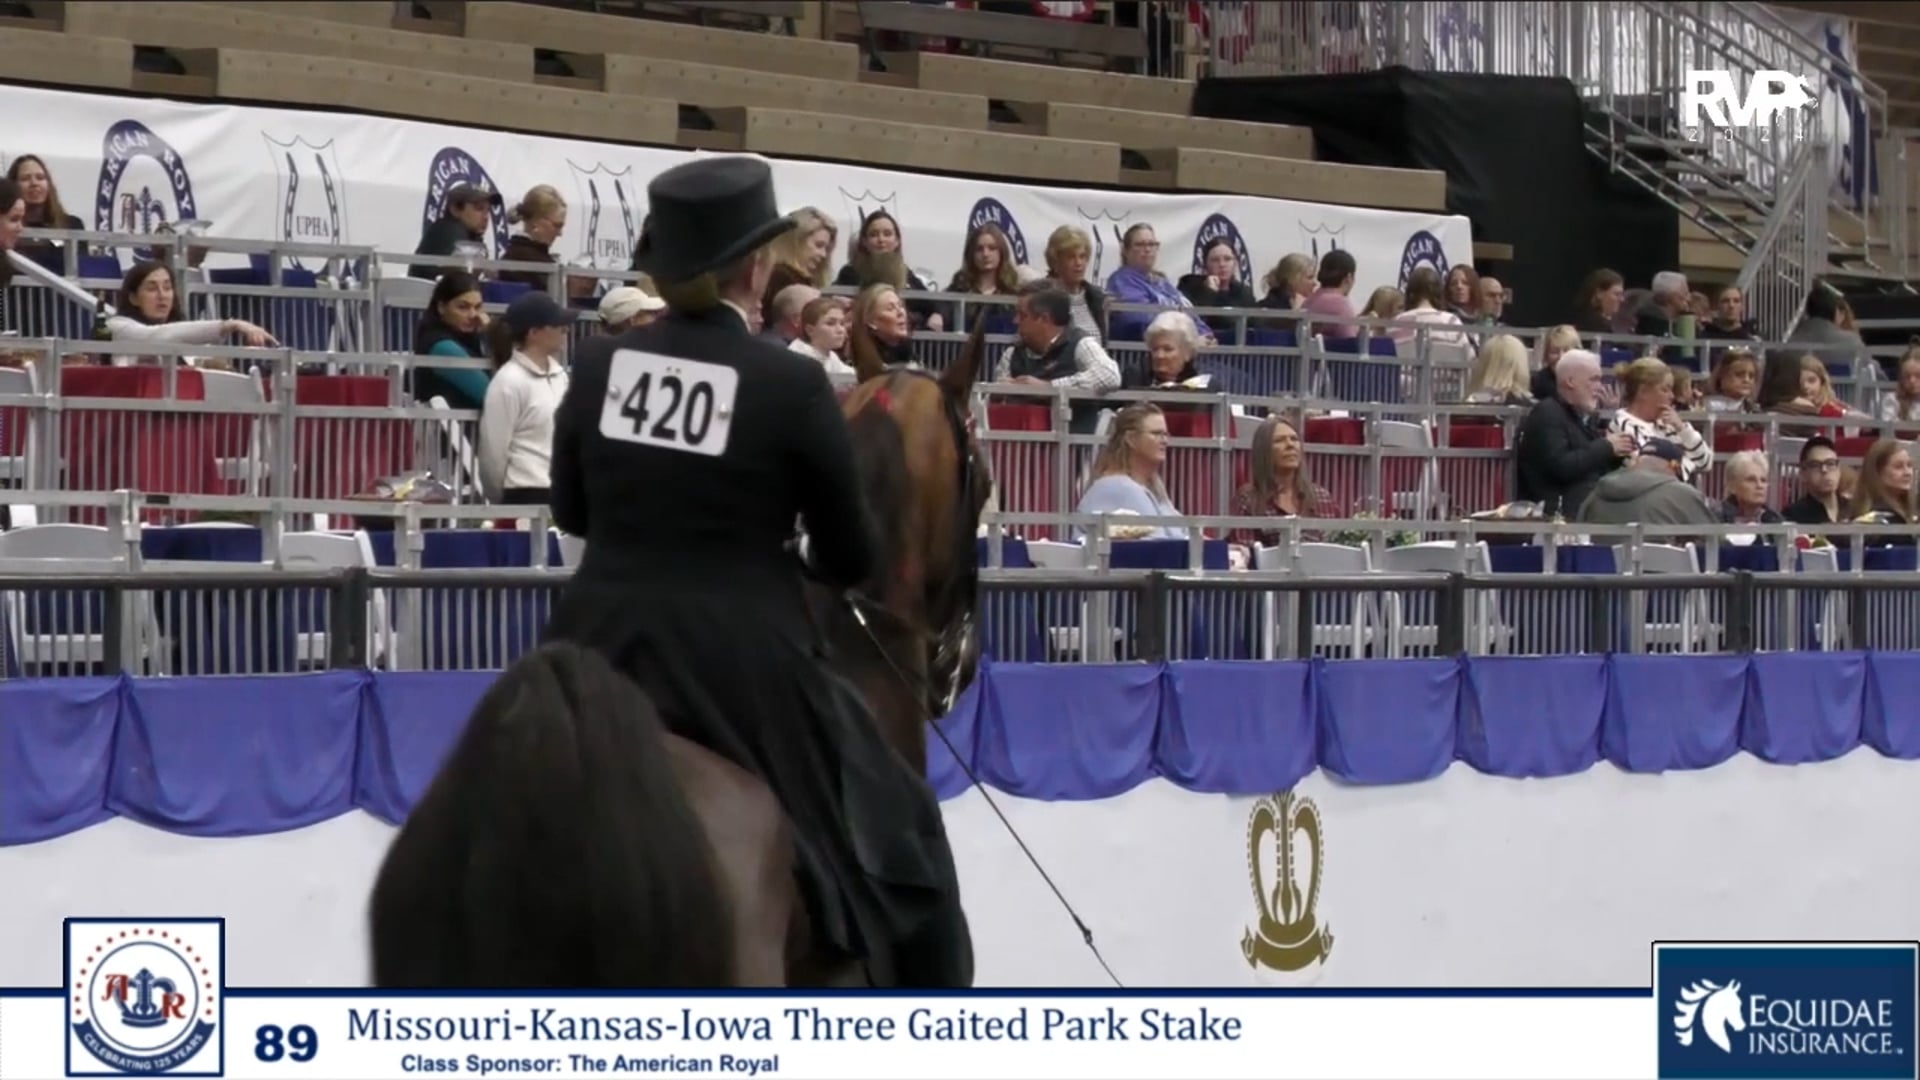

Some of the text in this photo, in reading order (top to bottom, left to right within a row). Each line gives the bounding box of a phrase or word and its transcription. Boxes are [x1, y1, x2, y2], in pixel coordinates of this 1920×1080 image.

[99, 130, 193, 232] MERICAN ROY
[427, 156, 471, 222] ERICAN
[296, 215, 330, 237] UPHA
[972, 205, 1002, 229] ICAN
[620, 371, 714, 446] 420
